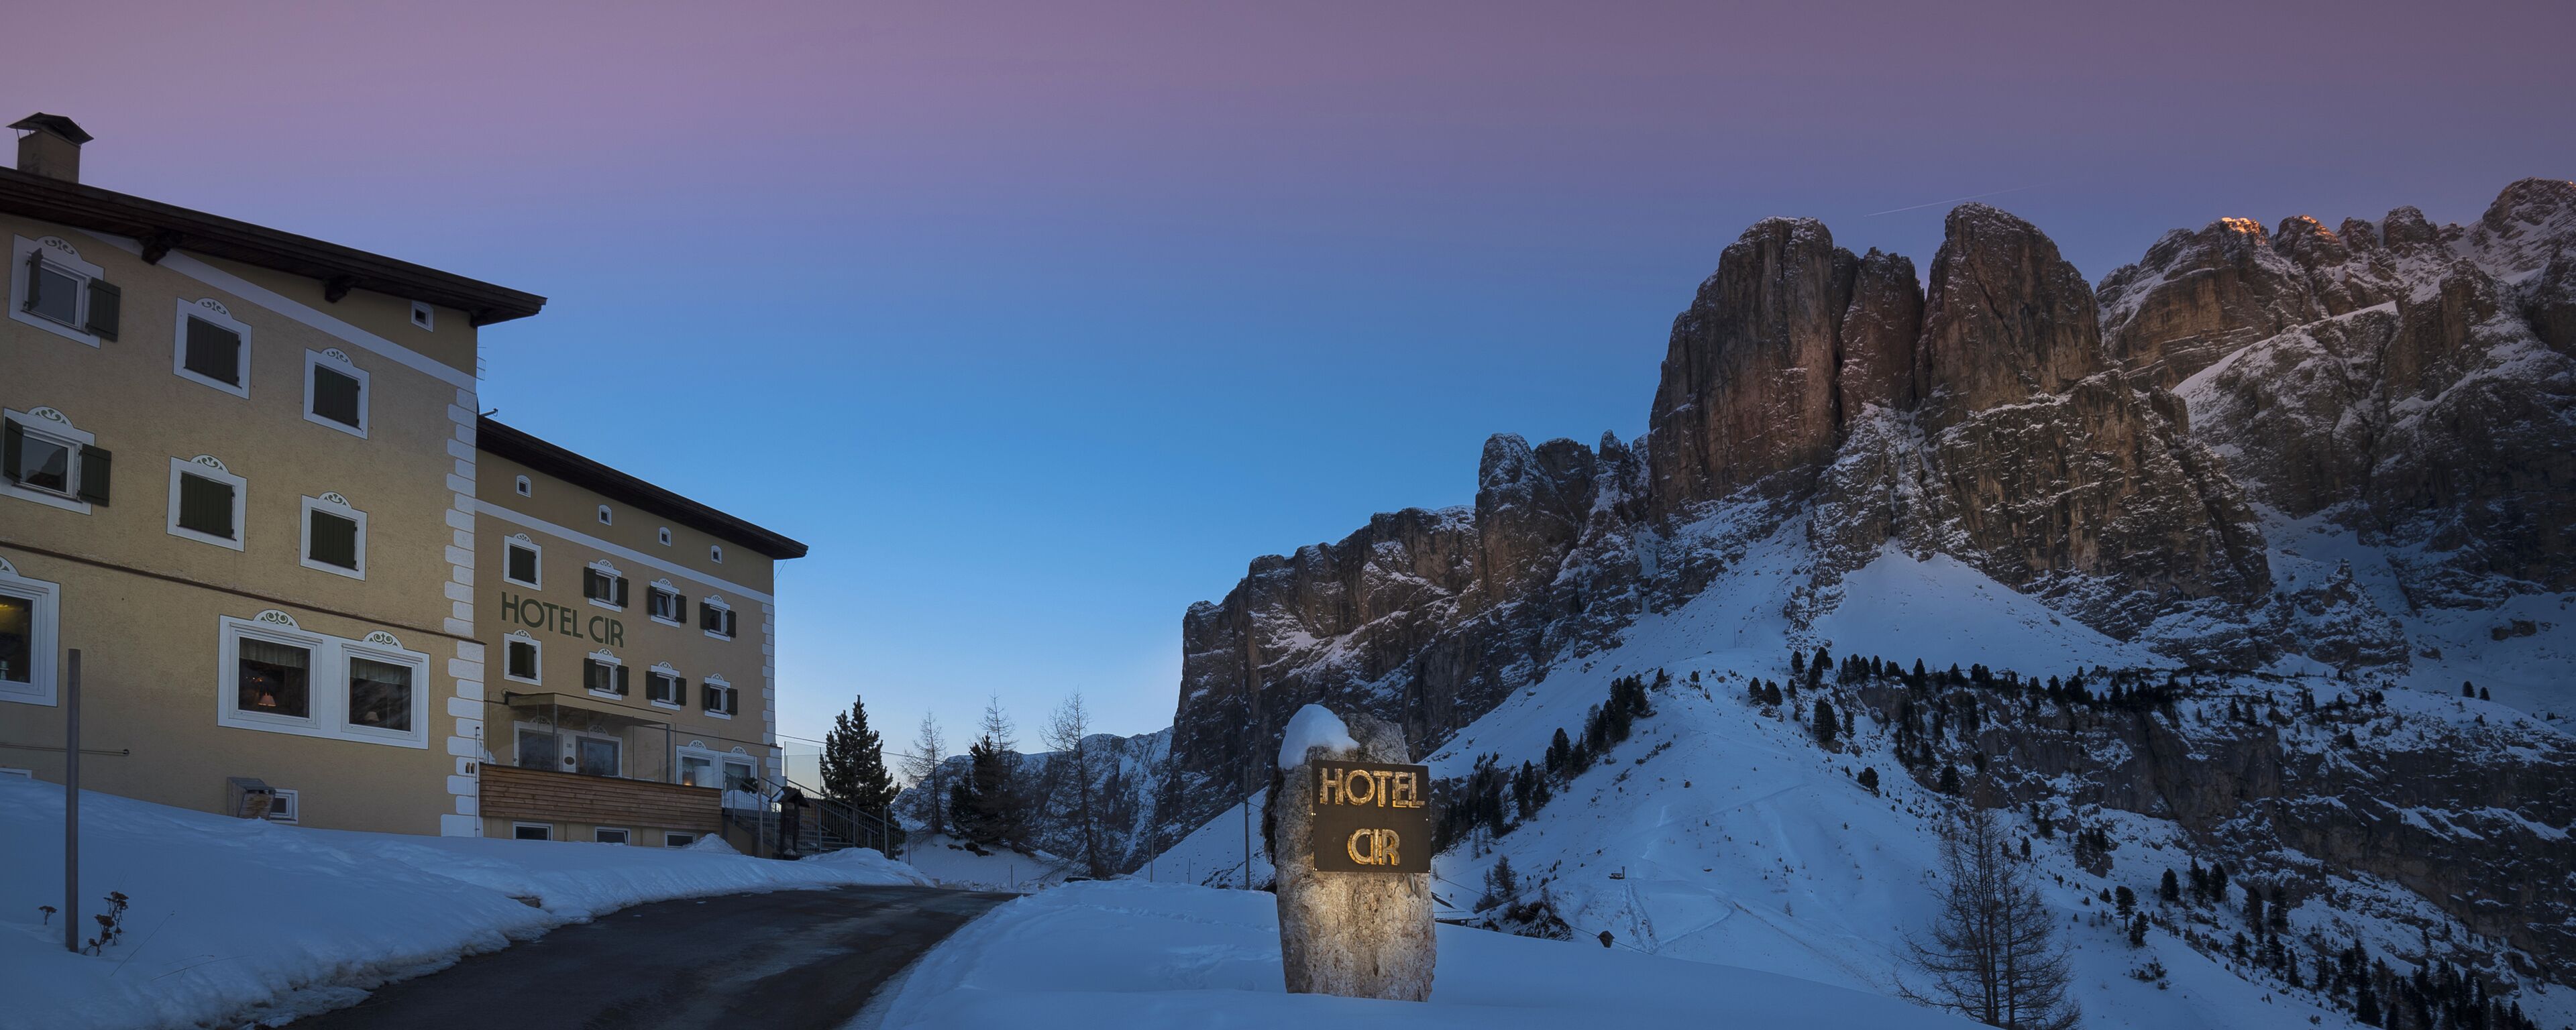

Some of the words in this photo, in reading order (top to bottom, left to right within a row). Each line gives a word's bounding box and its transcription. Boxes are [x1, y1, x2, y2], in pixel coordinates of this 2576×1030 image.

[501, 591, 584, 638] HOTEL
[588, 616, 624, 648] CIR
[1320, 768, 1426, 808] HOTEL
[1347, 828, 1400, 866] CIR
